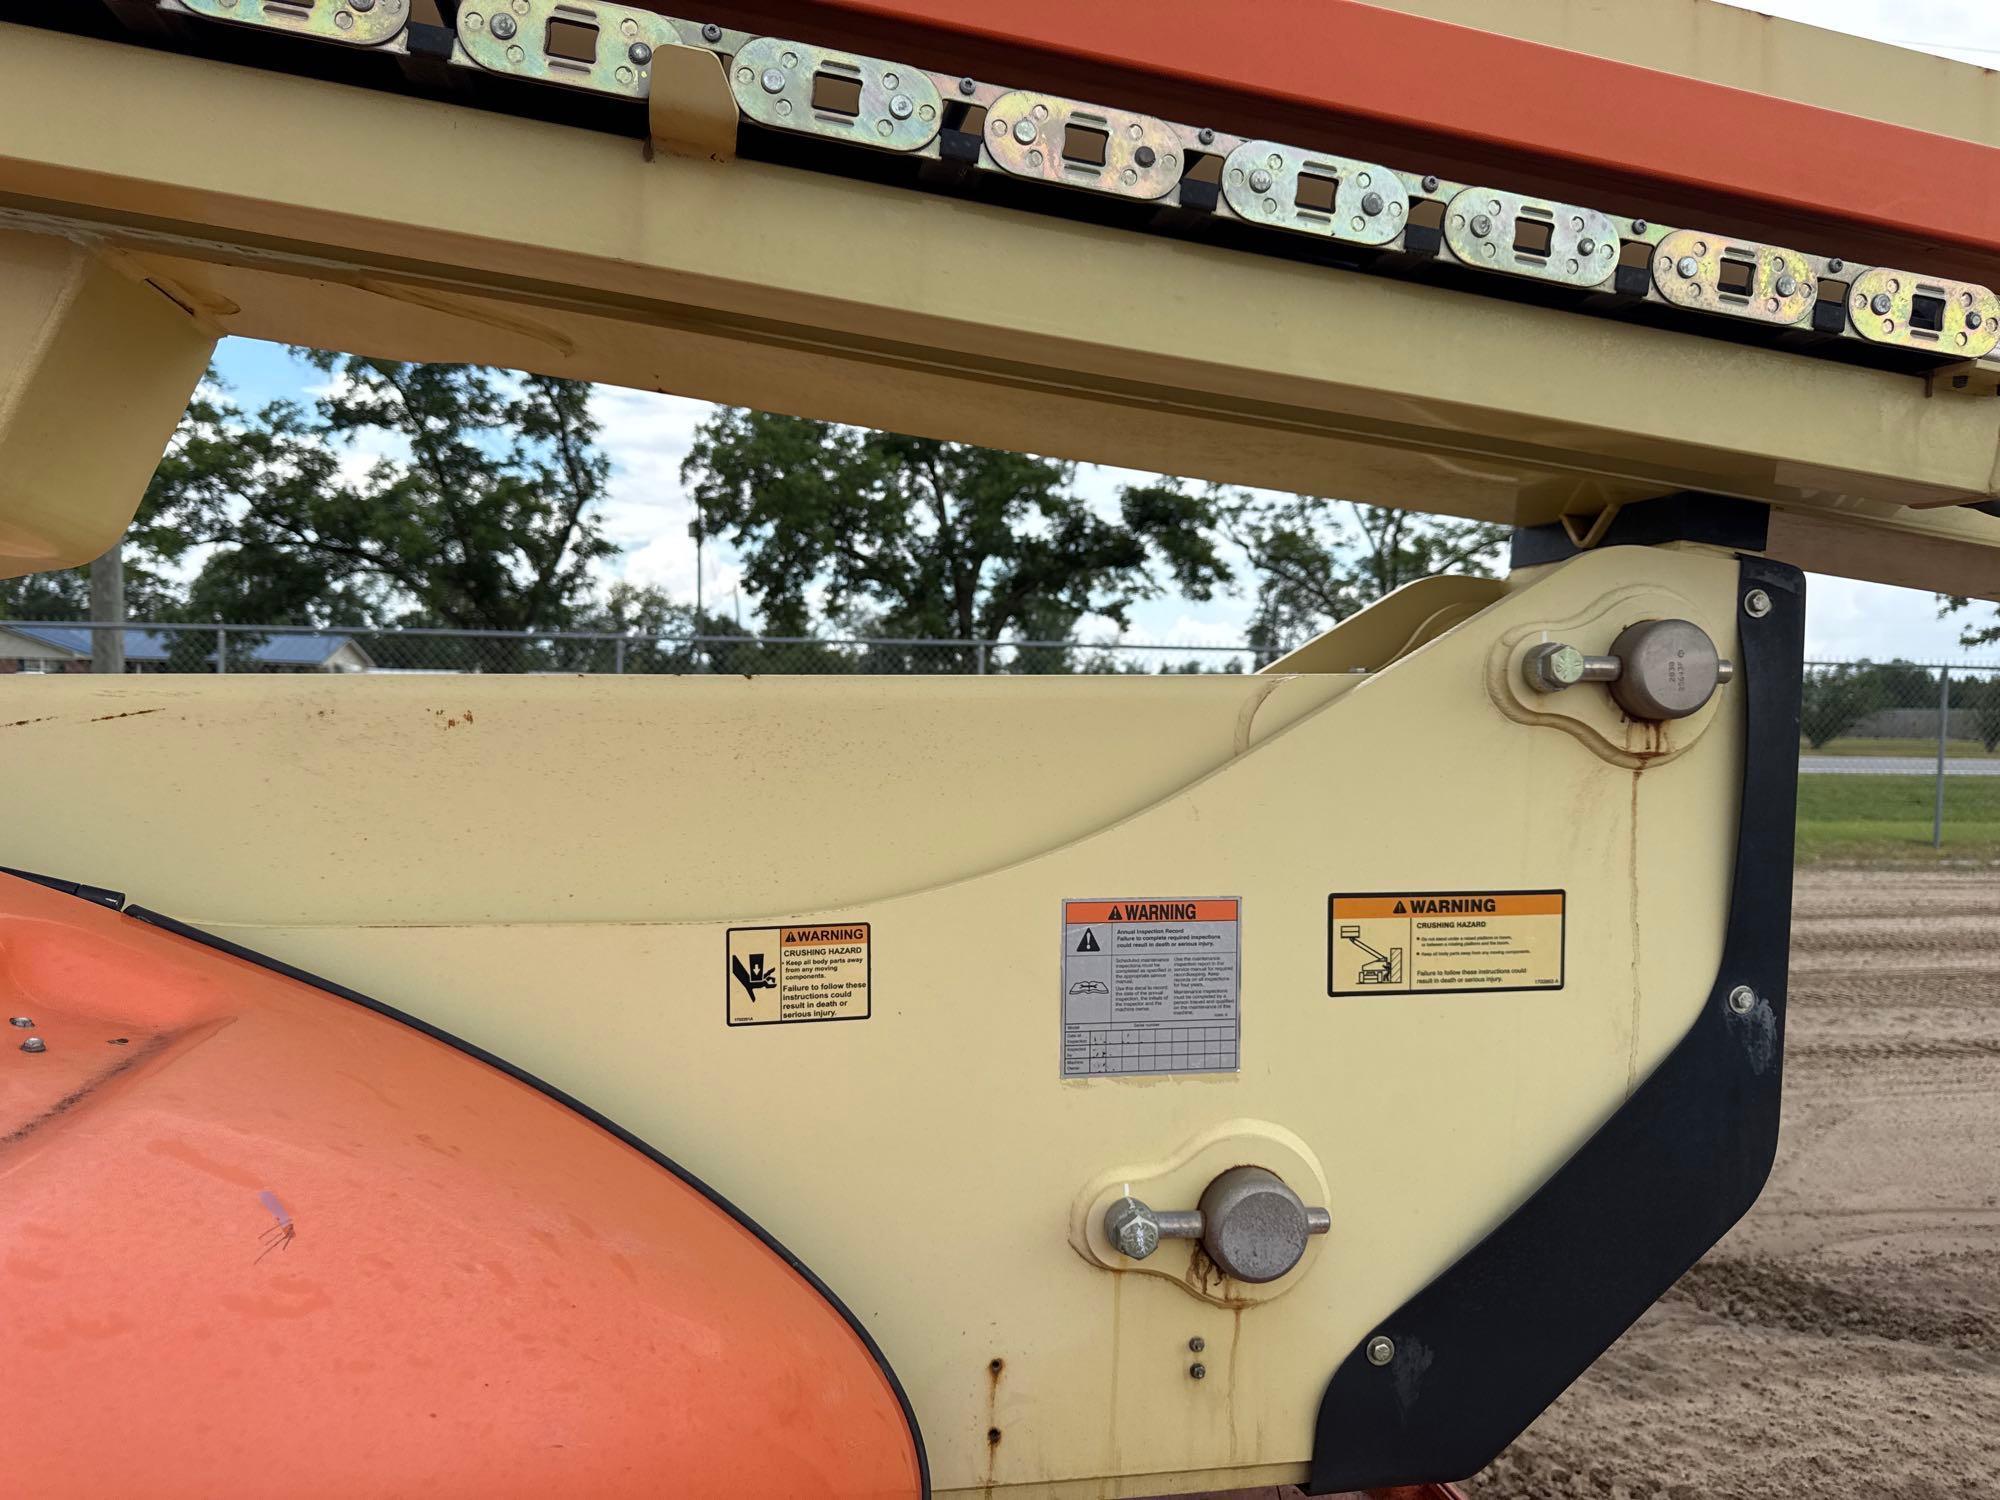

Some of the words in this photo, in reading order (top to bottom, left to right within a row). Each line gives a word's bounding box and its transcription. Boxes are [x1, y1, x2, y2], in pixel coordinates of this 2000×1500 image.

[1125, 904, 1196, 920] WARNING
[1411, 899, 1496, 913] WARNING
[798, 929, 863, 942] WARNING
[784, 948, 826, 957] CRUSHING
